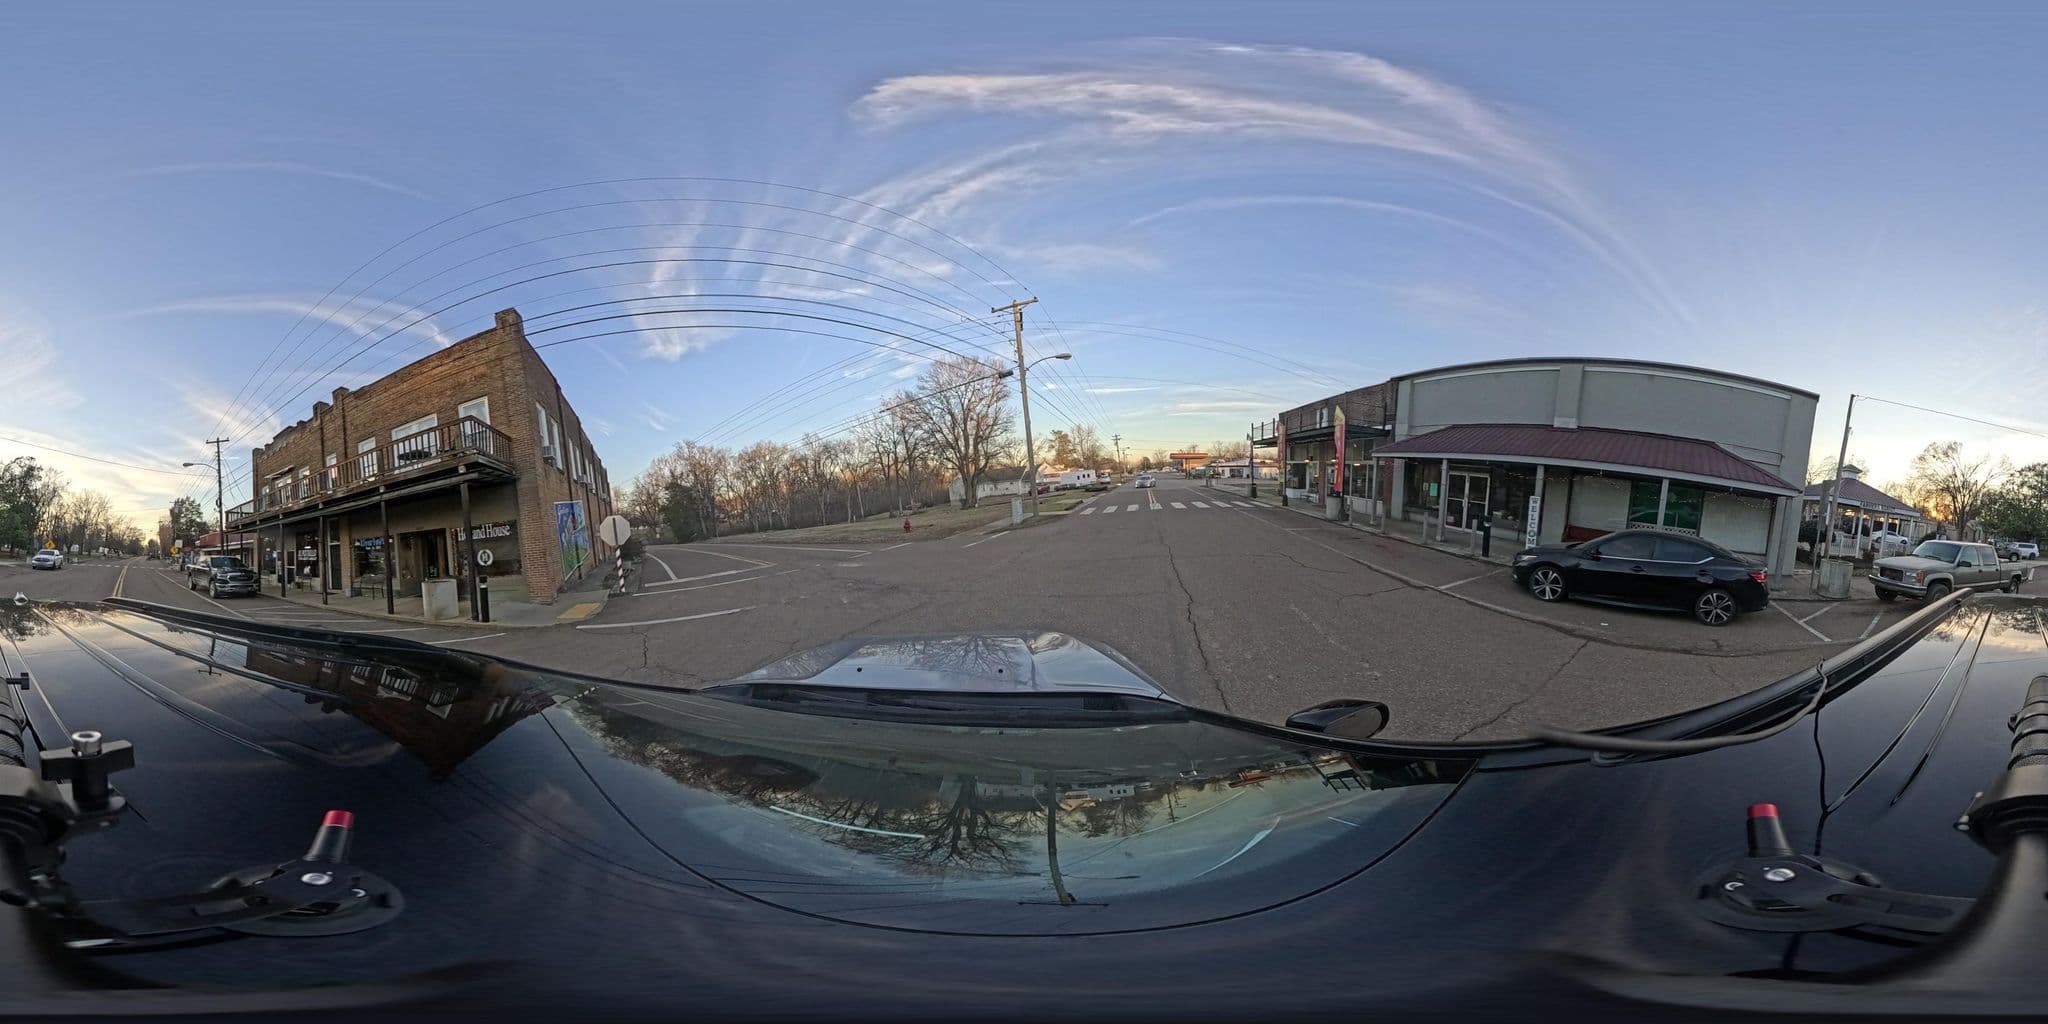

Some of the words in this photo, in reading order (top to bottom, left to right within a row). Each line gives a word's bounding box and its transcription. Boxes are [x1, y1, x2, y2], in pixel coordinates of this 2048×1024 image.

[457, 525, 485, 541] Hoand
[486, 524, 510, 537] House
[1528, 497, 1538, 548] WELCOM
